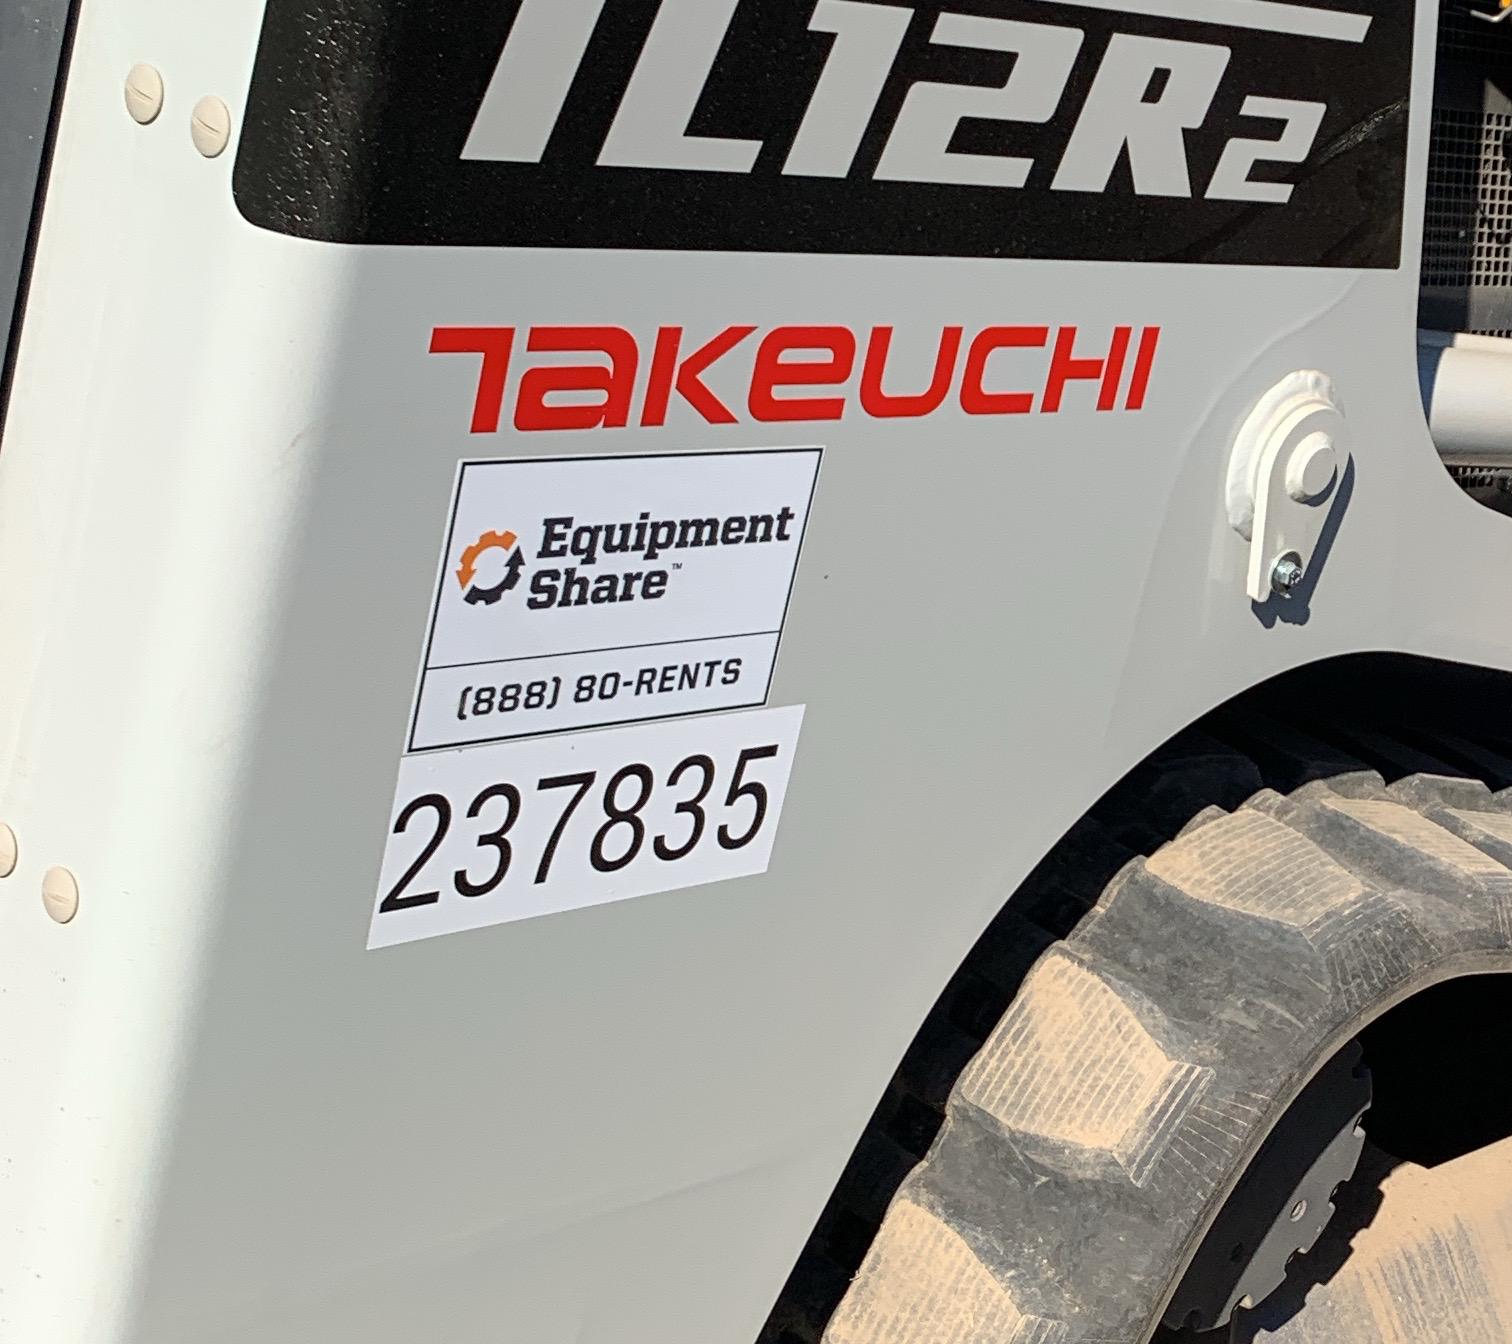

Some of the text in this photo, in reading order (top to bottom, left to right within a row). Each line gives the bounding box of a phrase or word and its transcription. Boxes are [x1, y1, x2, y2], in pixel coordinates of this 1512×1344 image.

[536, 506, 795, 565] Equipment
[456, 658, 743, 721] (888) 80-RENTS
[379, 744, 779, 915] 237835
